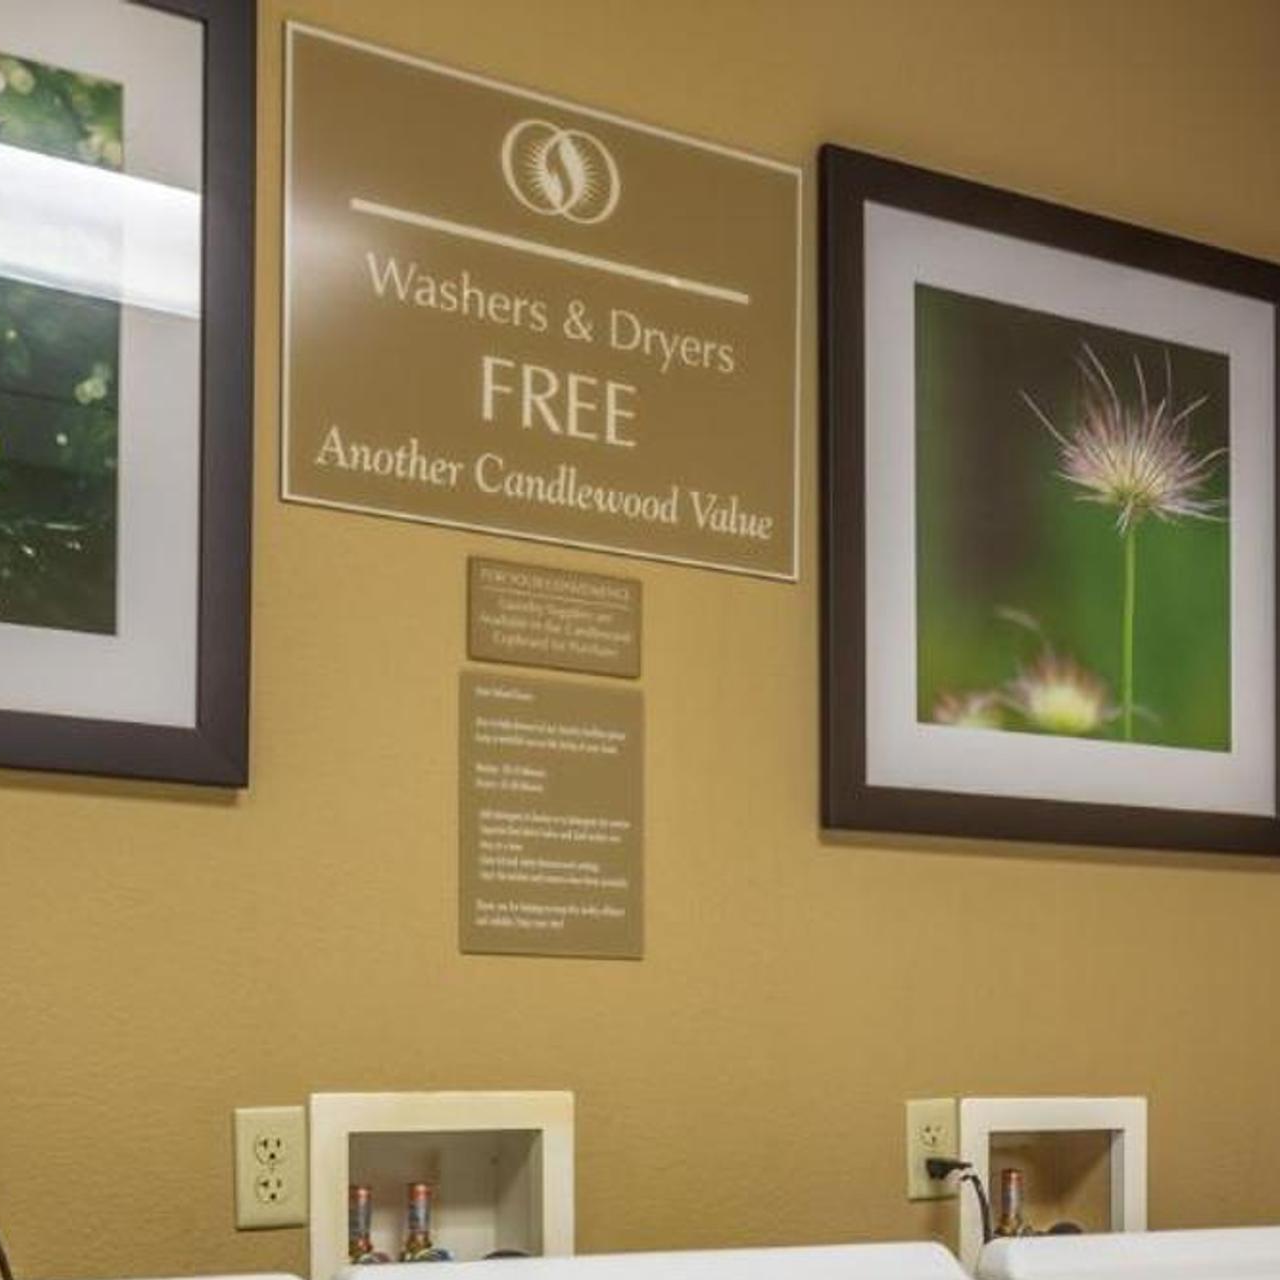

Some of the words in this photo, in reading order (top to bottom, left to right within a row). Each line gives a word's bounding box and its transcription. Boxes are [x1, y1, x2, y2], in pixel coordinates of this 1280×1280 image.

[367, 252, 548, 333] Washers
[562, 300, 594, 342] &
[610, 309, 735, 374] Dryers
[480, 355, 637, 447] FREE
[316, 425, 464, 486] Another
[475, 453, 678, 525] Candlewood
[690, 489, 774, 540] Value
